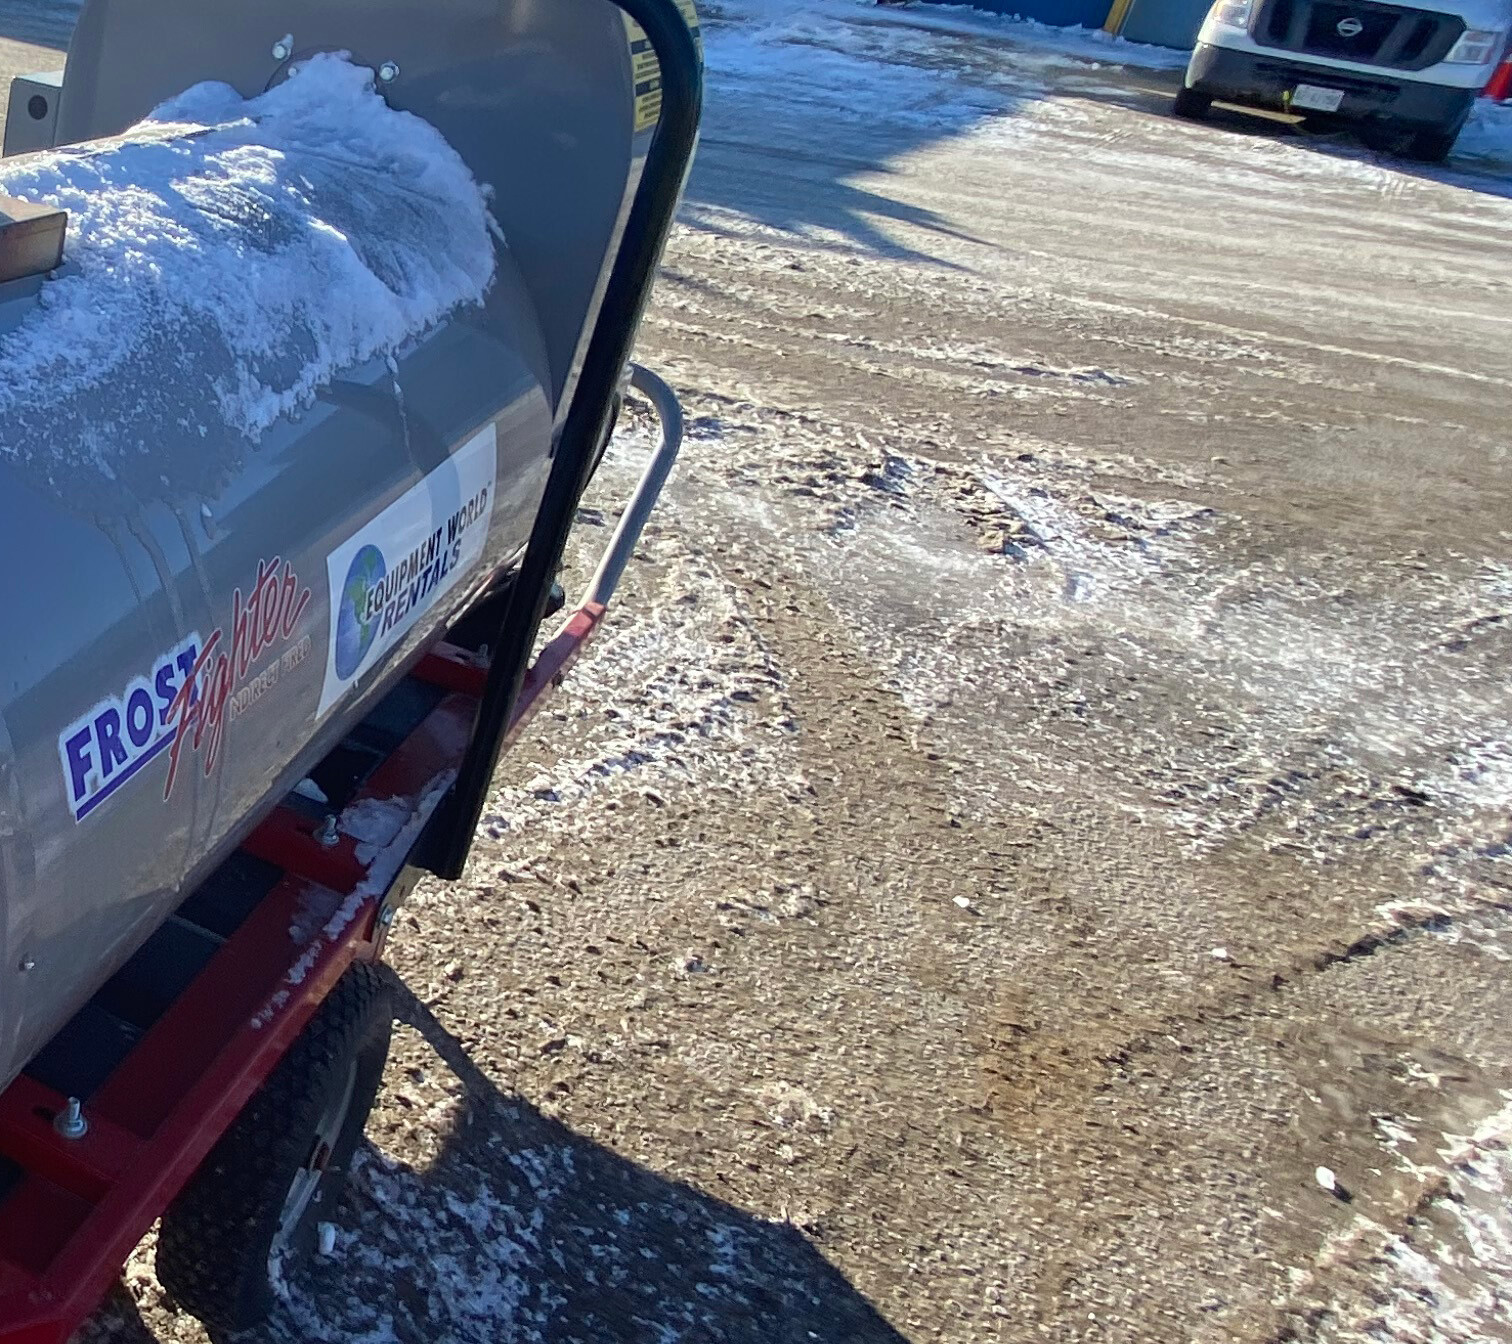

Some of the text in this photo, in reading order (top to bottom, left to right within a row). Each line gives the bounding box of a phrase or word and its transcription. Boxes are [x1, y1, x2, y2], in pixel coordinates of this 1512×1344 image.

[365, 527, 443, 621] EQUIPMENT
[381, 538, 462, 638] RENTALS
[65, 556, 312, 803] FROST Fighter
